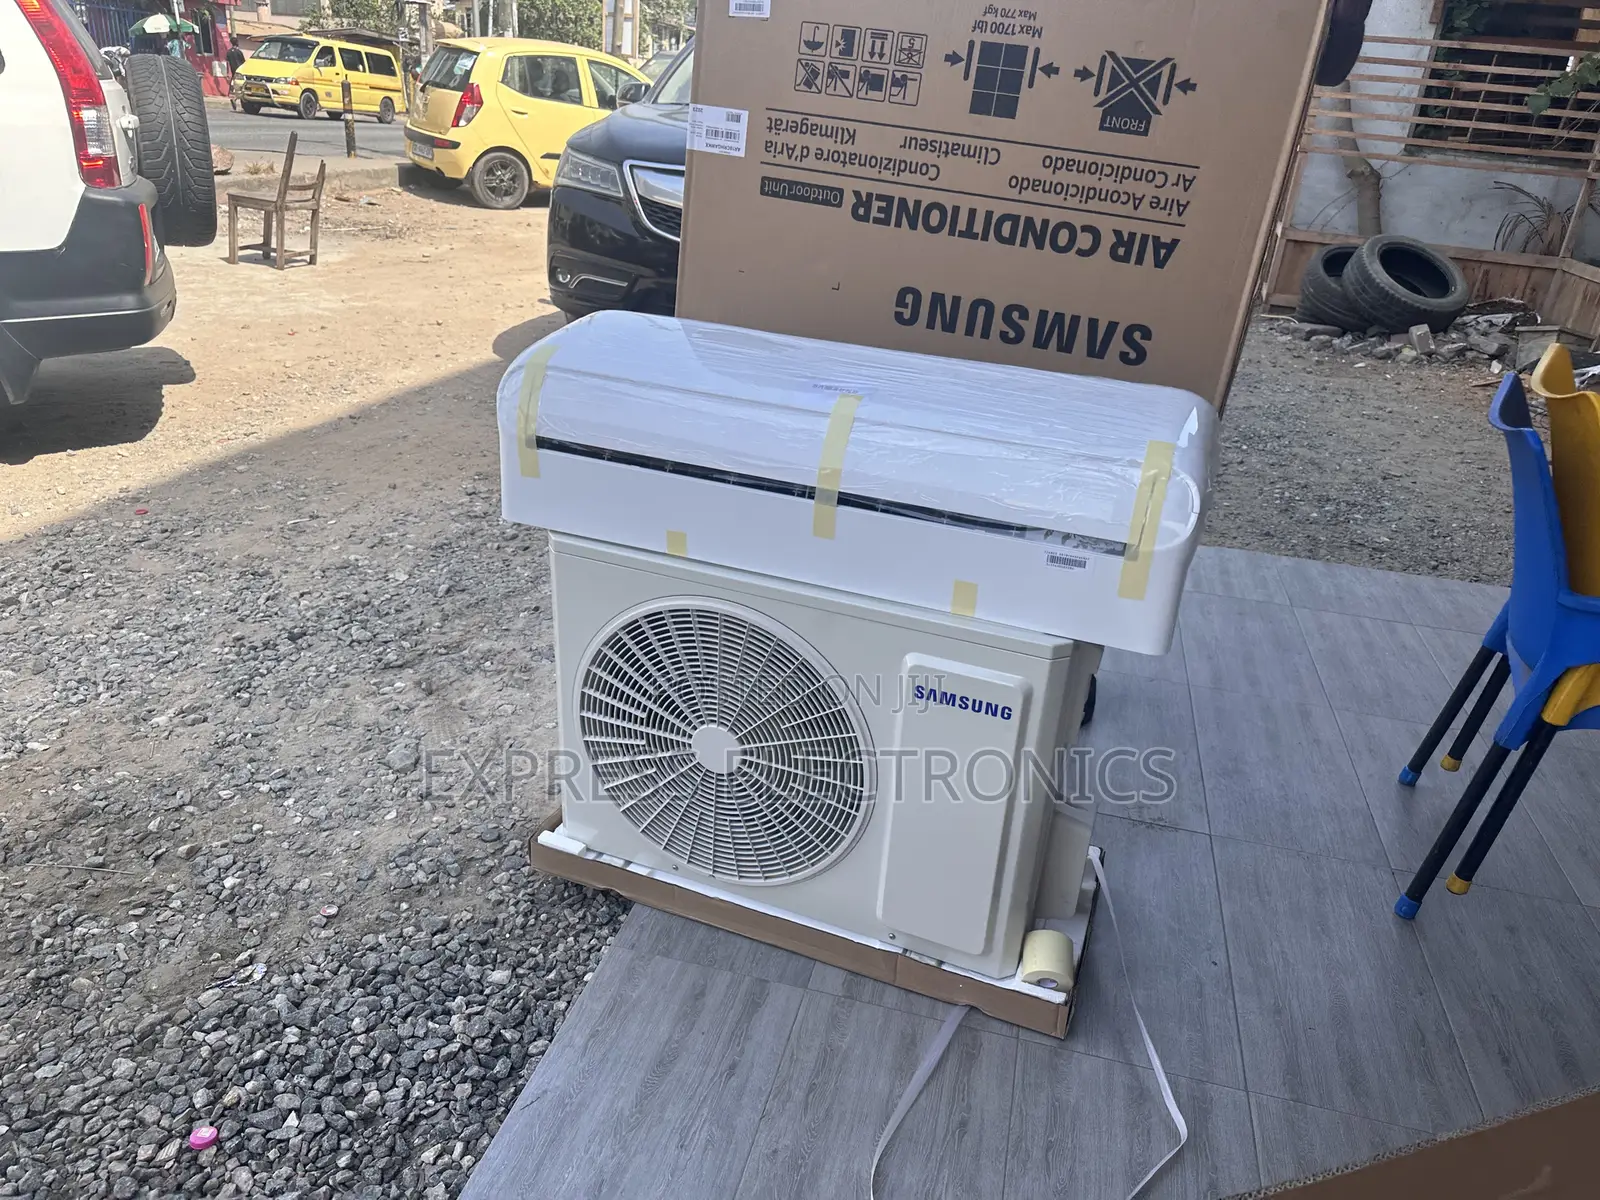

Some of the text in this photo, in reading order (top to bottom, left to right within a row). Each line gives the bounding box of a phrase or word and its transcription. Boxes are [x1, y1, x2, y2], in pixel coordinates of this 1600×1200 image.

[971, 19, 1044, 39] Max 1700 lbf
[982, 3, 1038, 21] Max 770 kgf
[766, 117, 857, 146] Klimagerät
[1103, 115, 1146, 132] FRONT
[764, 139, 941, 182] Condizionatore d'Aria
[899, 135, 1001, 166] Climatiseur
[1042, 154, 1197, 193] Ar Condicionado
[763, 180, 840, 204] Outdoor Unit
[1008, 174, 1190, 218] Aire Acondicionado
[850, 190, 1181, 270] AIR CONDITIONER
[893, 286, 1153, 367] SAMSUNG
[913, 684, 1013, 721] SAMSUNG
